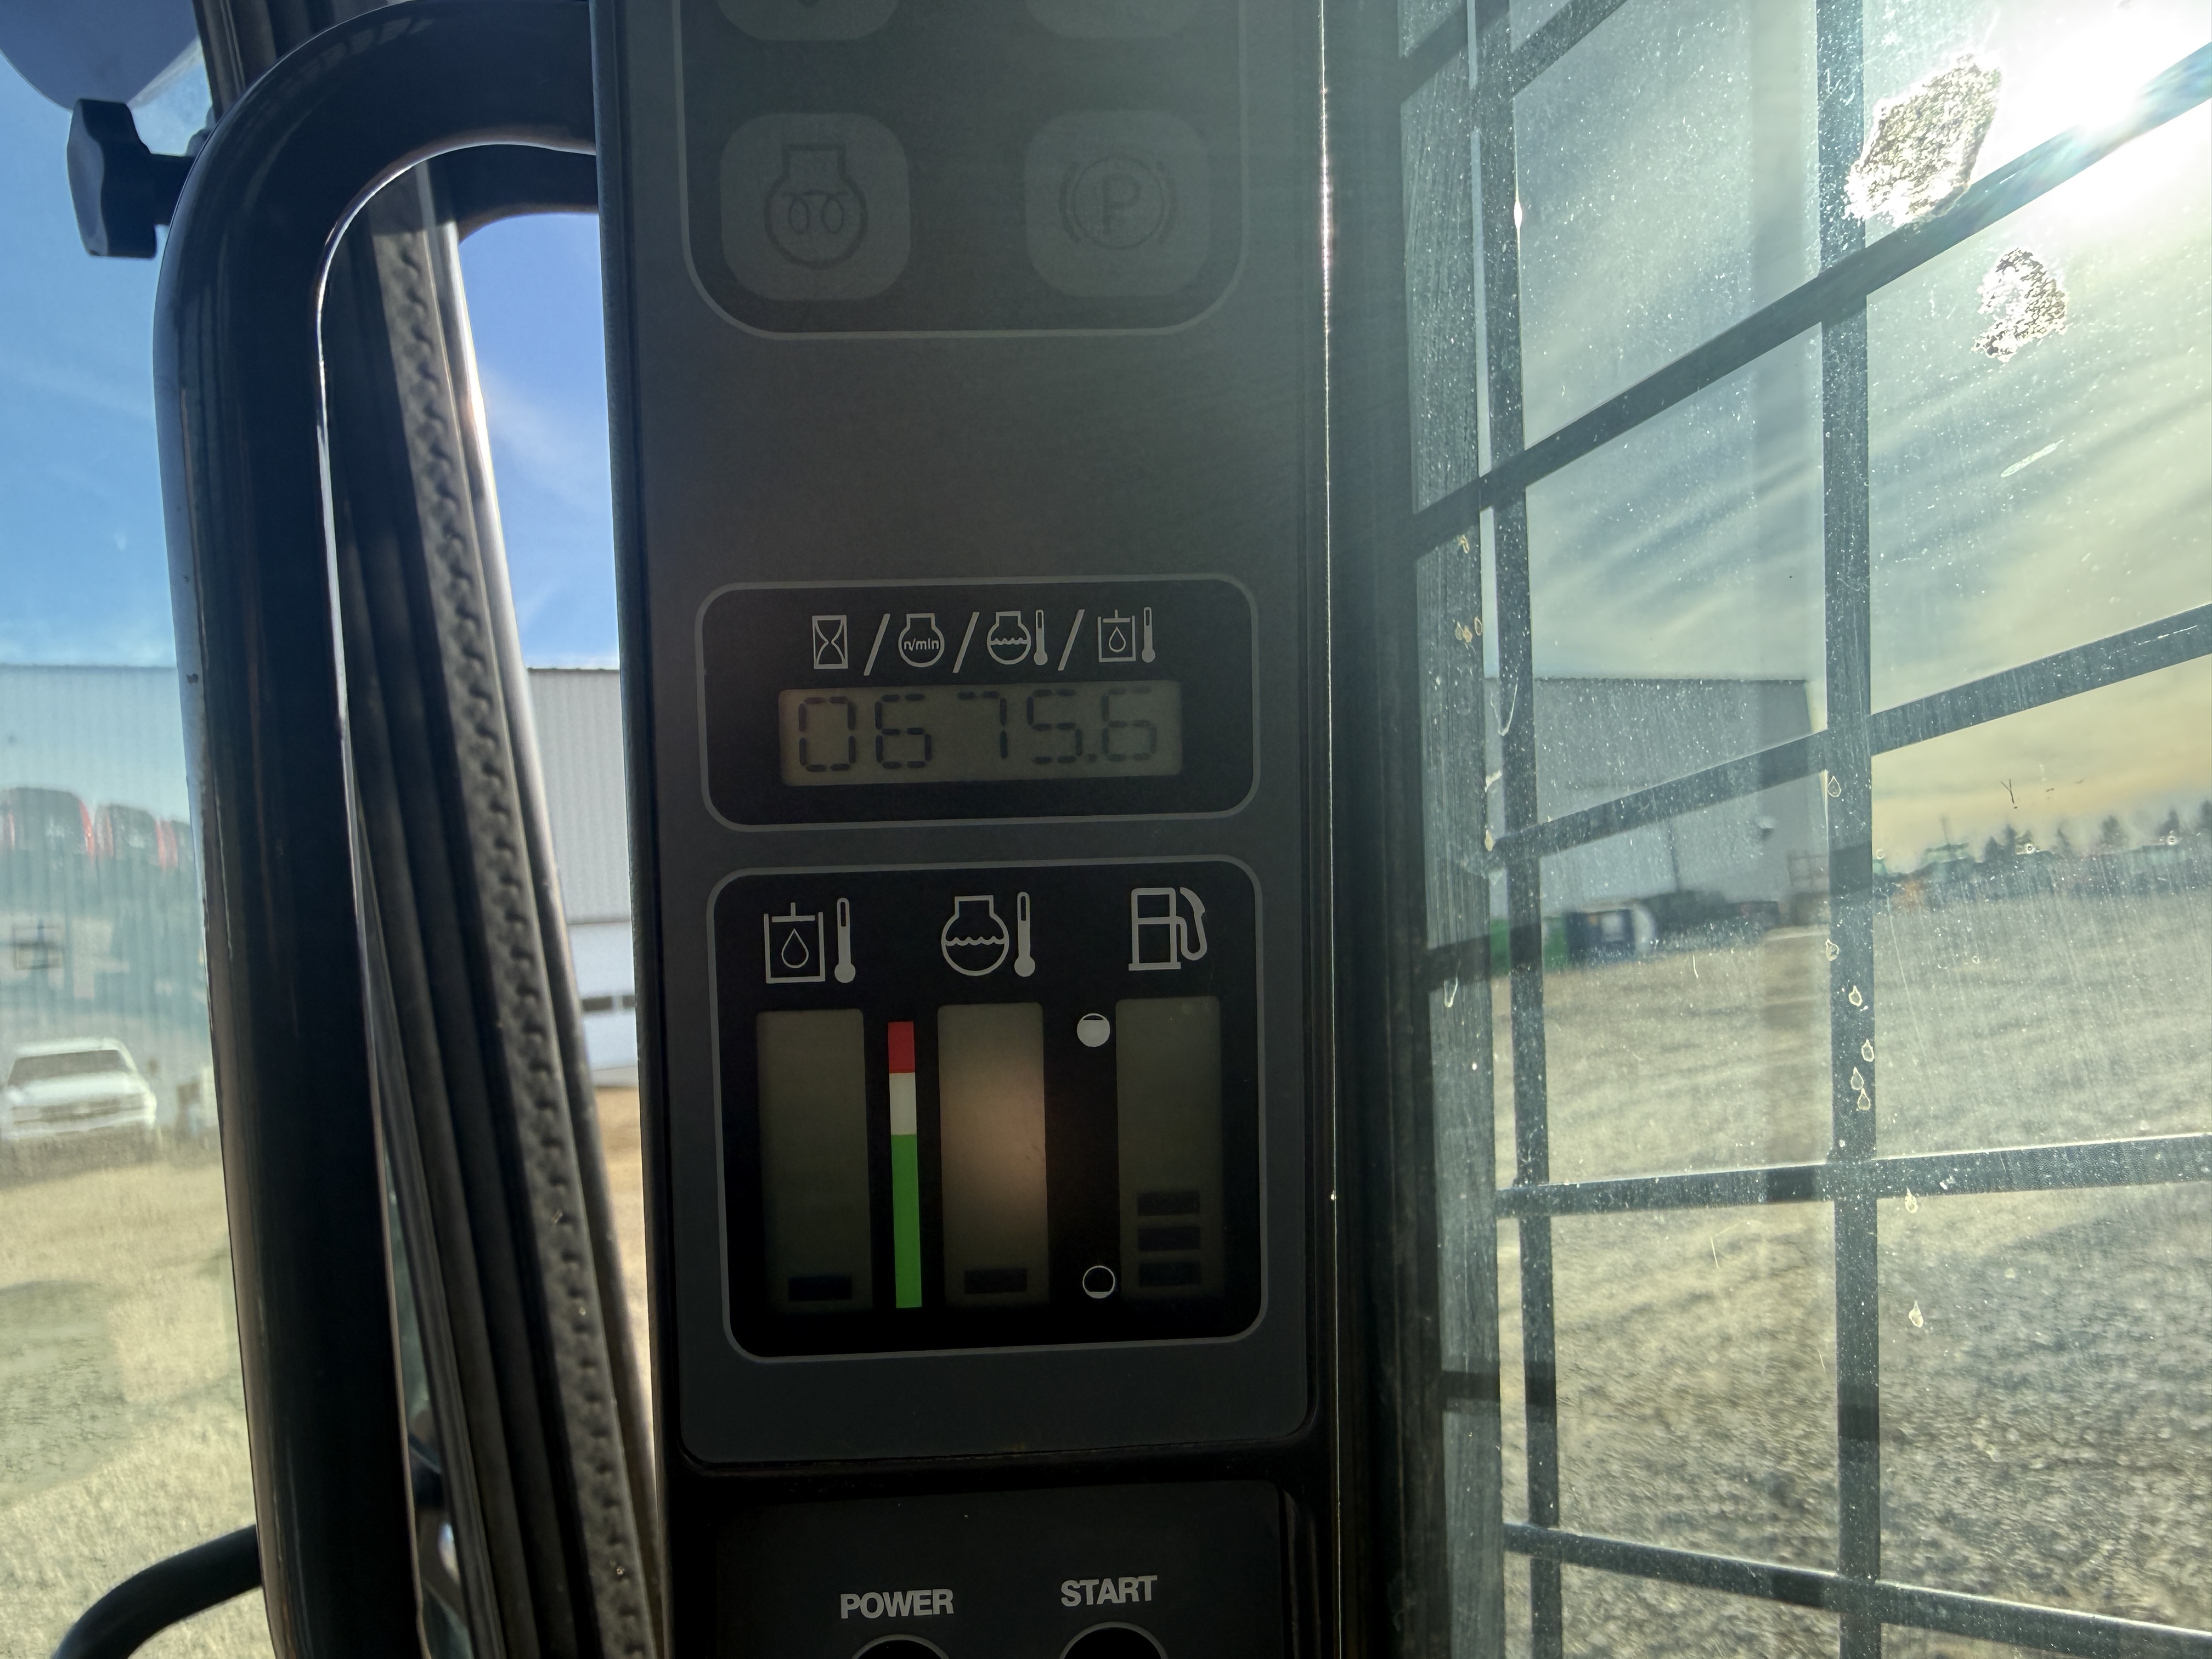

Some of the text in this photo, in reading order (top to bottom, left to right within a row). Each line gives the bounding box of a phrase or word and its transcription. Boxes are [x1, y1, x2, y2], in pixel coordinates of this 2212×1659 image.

[1101, 173, 1142, 235] P
[798, 689, 1157, 772] 0675.6
[840, 1589, 954, 1618] POWER
[1060, 1576, 1157, 1607] START
